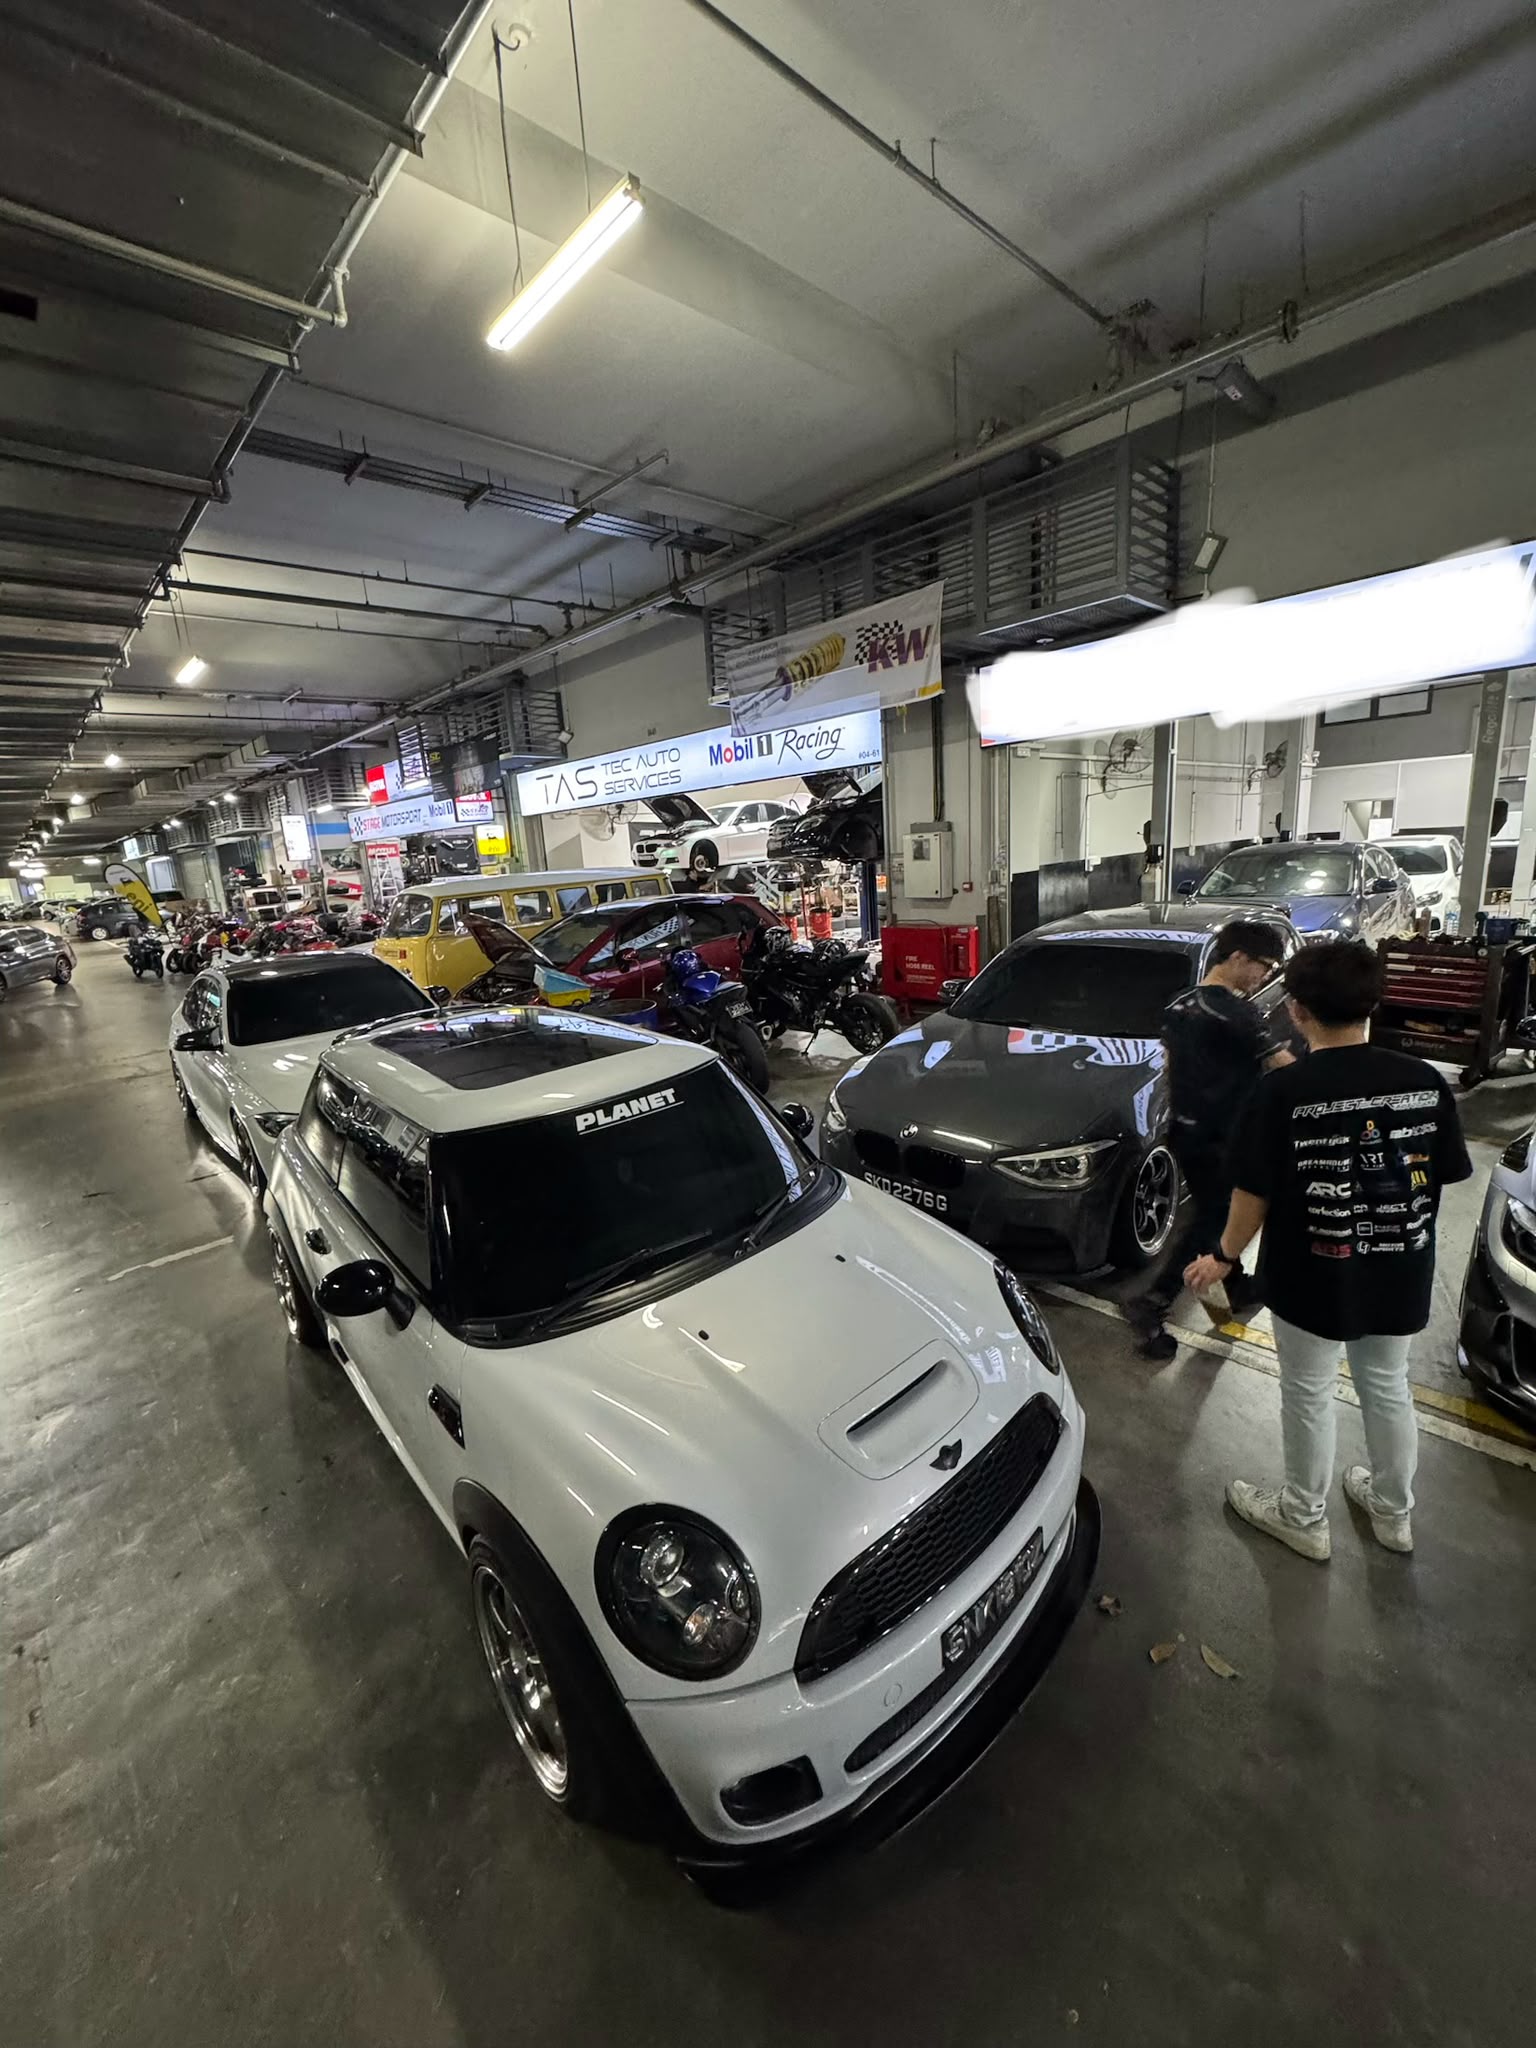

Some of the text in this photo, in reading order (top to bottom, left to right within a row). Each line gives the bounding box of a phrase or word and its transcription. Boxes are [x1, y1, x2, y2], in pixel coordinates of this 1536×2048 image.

[868, 625, 933, 673] KW
[709, 726, 845, 767] Mobil 1 Racing
[601, 748, 681, 776] TEC AUTO
[536, 765, 598, 805] TAS
[604, 769, 682, 796] SERVICES
[127, 892, 152, 912] eni
[575, 1088, 676, 1132] PLANET
[1292, 1098, 1366, 1119] PROJECT
[1306, 1182, 1352, 1197] ARC
